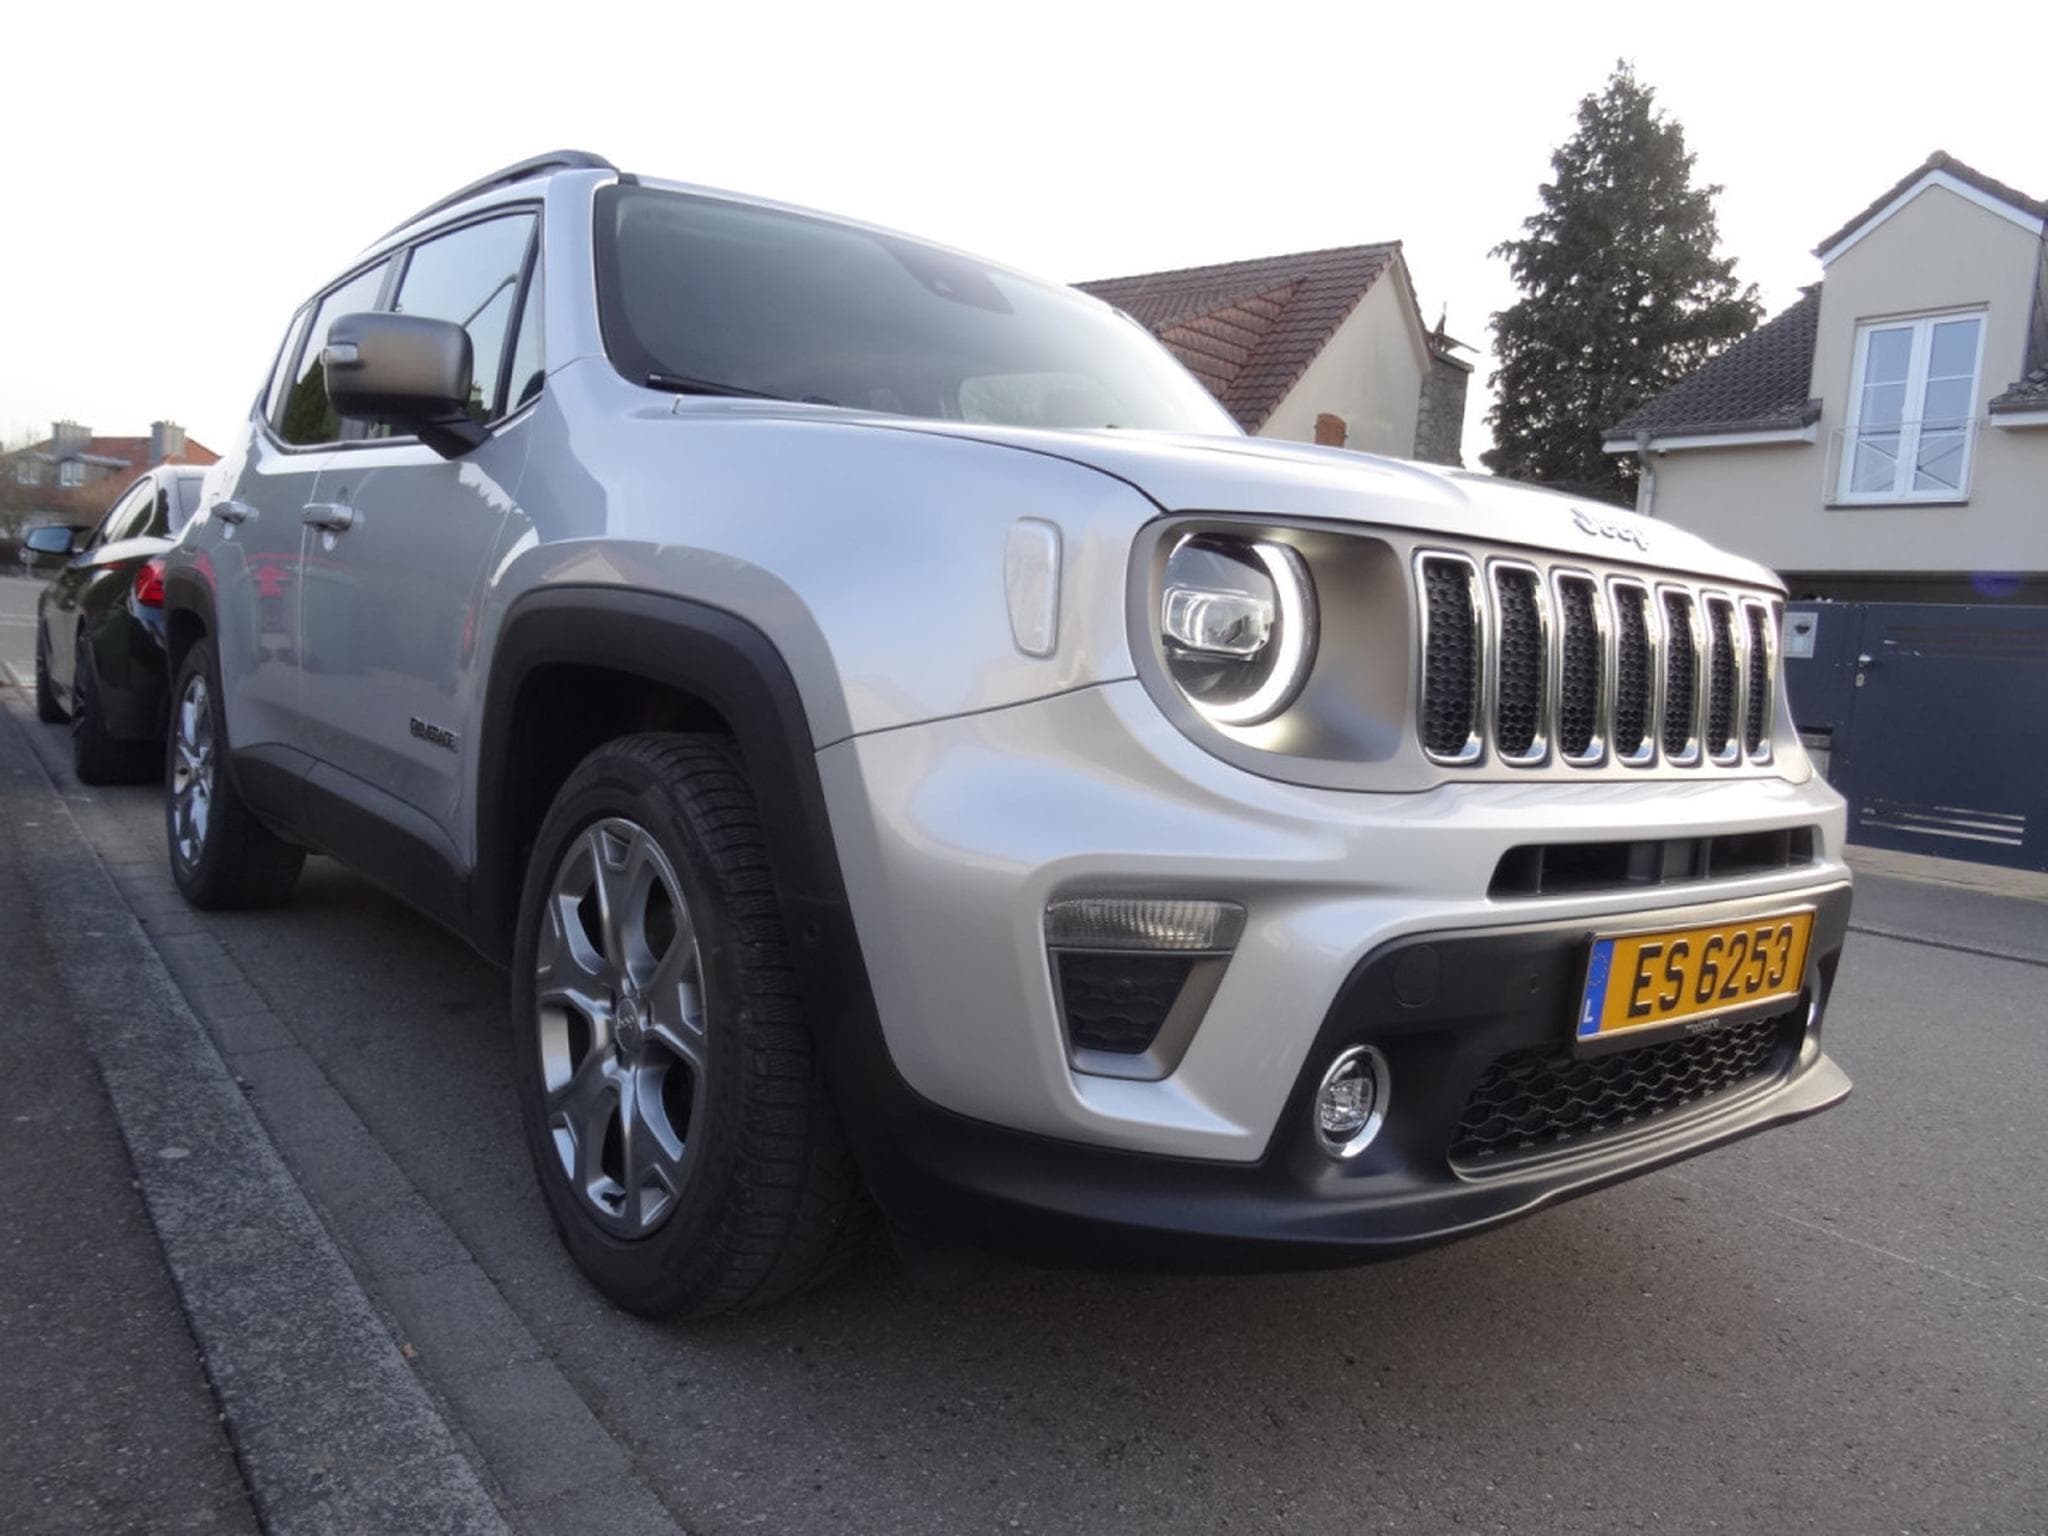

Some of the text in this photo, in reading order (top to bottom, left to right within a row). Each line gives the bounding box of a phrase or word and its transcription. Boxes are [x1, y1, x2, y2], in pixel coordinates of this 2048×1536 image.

[1627, 922, 1793, 1018] ES 6253
[1583, 998, 1593, 1023] L
